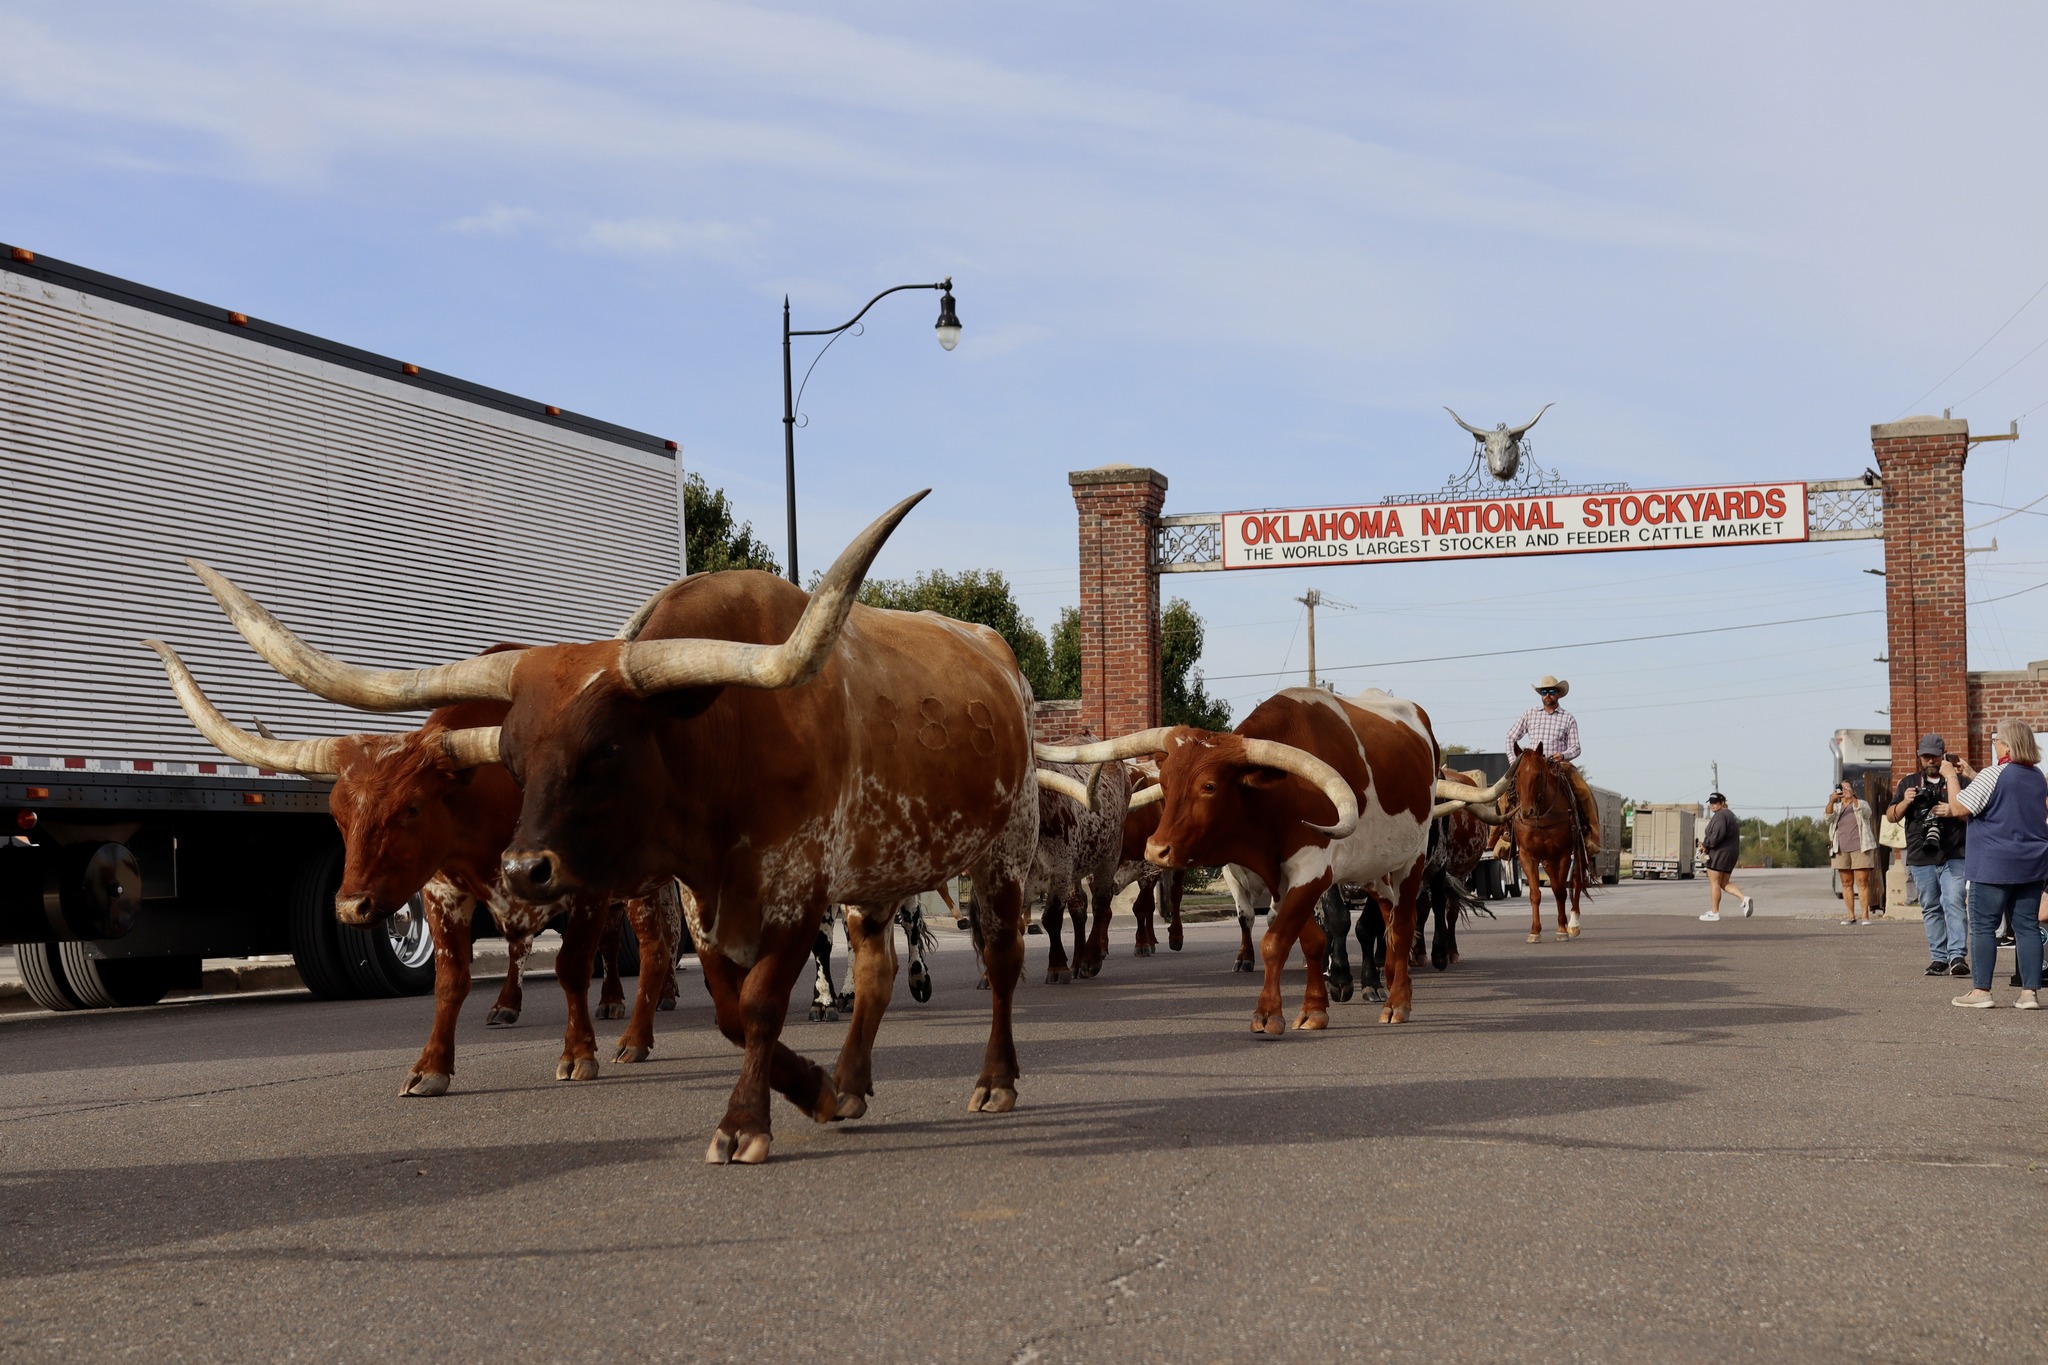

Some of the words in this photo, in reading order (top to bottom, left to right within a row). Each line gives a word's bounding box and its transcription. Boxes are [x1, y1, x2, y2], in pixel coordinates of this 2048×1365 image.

[1240, 509, 1404, 546] OKLAHOMA
[1421, 501, 1564, 536] NATIONAL
[1582, 488, 1787, 528] STOCKYARDS
[1244, 547, 1274, 561] THE
[1282, 544, 1348, 559] WORLDS
[1356, 540, 1431, 556] LARGEST
[1439, 536, 1517, 552] STOCKER
[1525, 532, 1559, 548] AND
[1567, 529, 1630, 545] FEEDER
[1638, 526, 1703, 542] CATTLE
[1712, 521, 1784, 537] MARKET
